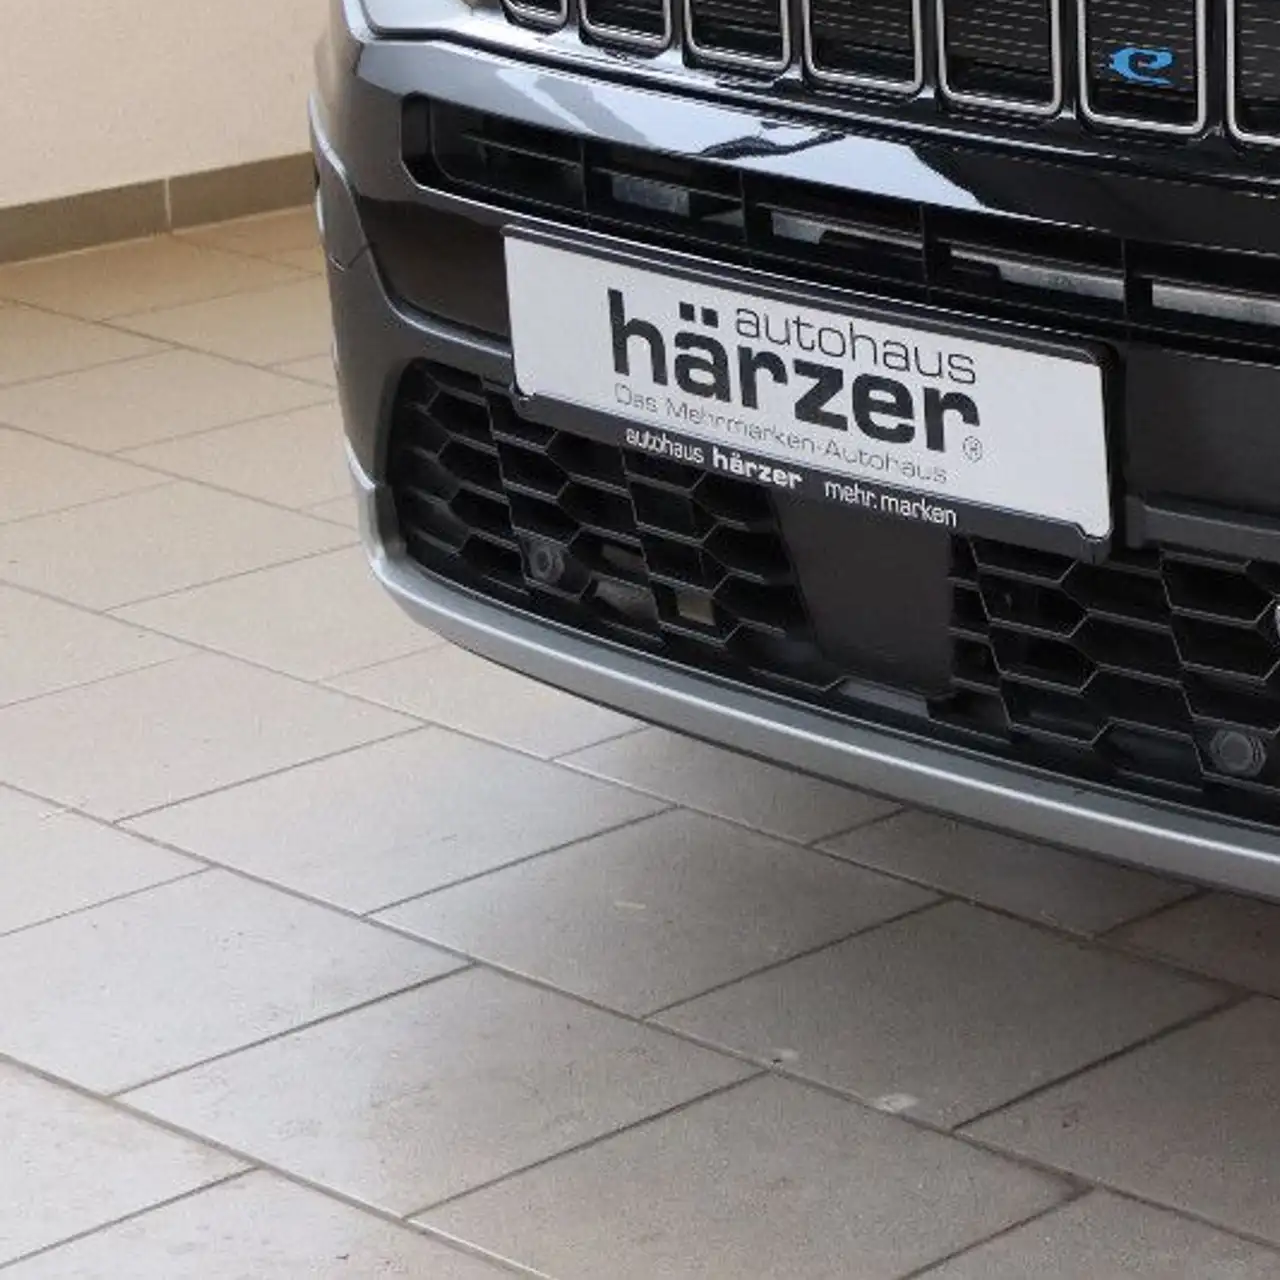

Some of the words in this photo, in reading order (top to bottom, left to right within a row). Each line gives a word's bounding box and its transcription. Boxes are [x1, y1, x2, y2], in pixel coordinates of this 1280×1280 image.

[606, 288, 981, 453] härzer
[734, 307, 977, 385] autohaus
[615, 383, 658, 414] Das
[665, 393, 948, 484] Mehrmarken-Autohaus
[624, 427, 704, 464] autohaus
[711, 446, 802, 490] härzer
